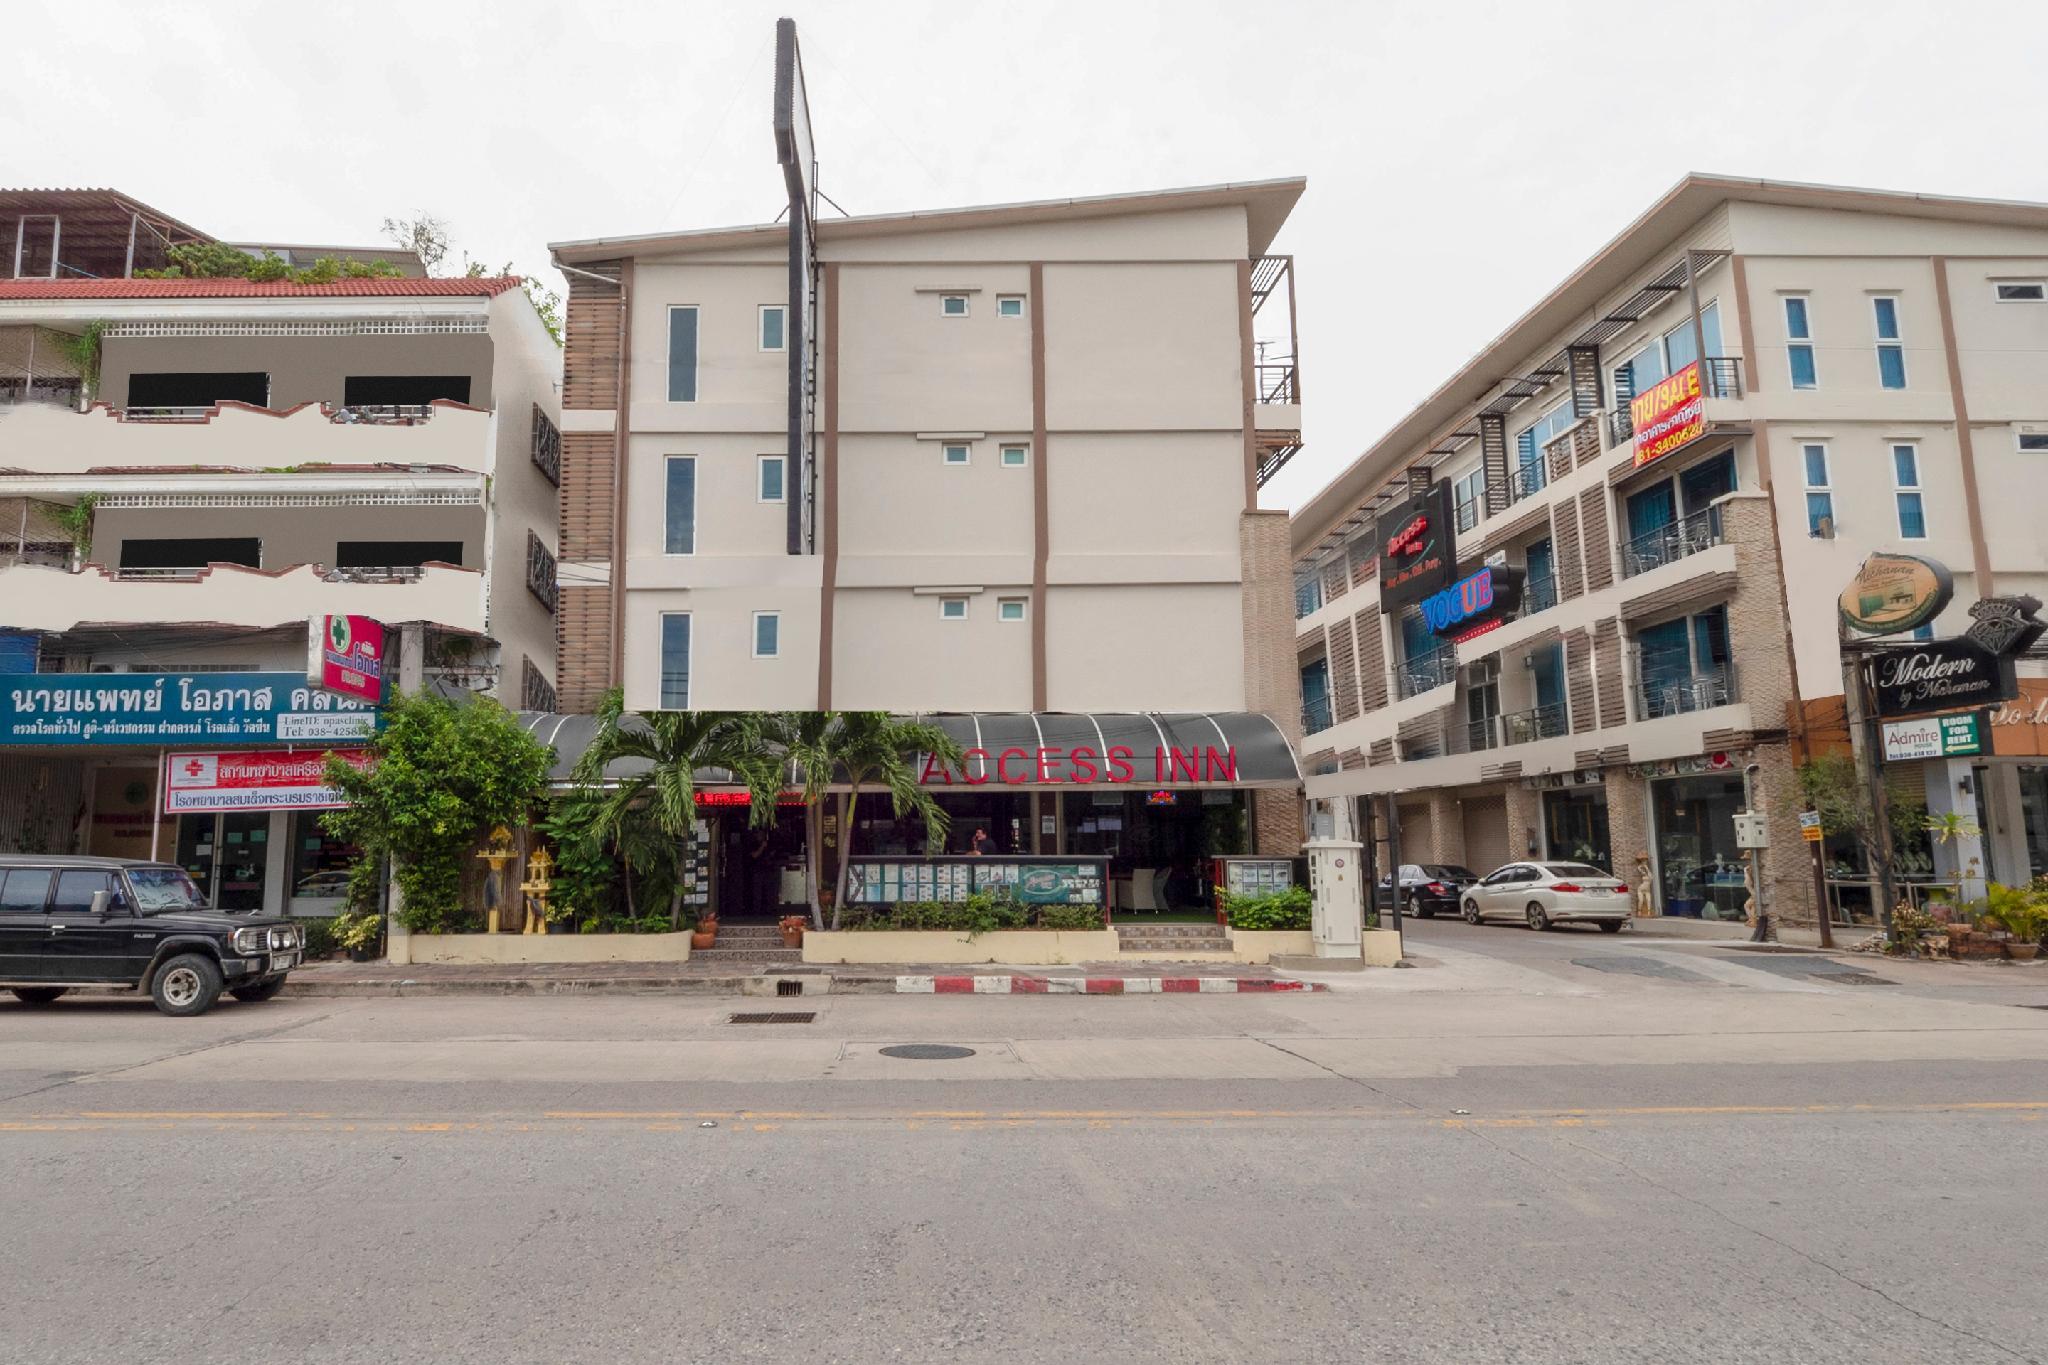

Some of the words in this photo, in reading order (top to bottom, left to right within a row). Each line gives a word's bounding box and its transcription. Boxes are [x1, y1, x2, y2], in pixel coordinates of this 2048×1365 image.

[1421, 567, 1493, 634] VOGUE
[1880, 653, 1975, 688] Modern
[11, 678, 165, 713] นายแพทย์
[178, 678, 273, 712] โอภาส
[1888, 729, 1938, 746] Admire
[1942, 715, 1973, 728] ROOM
[1949, 725, 1969, 735] FOR
[921, 746, 1135, 784] ACCESS
[1156, 746, 1236, 783] INN
